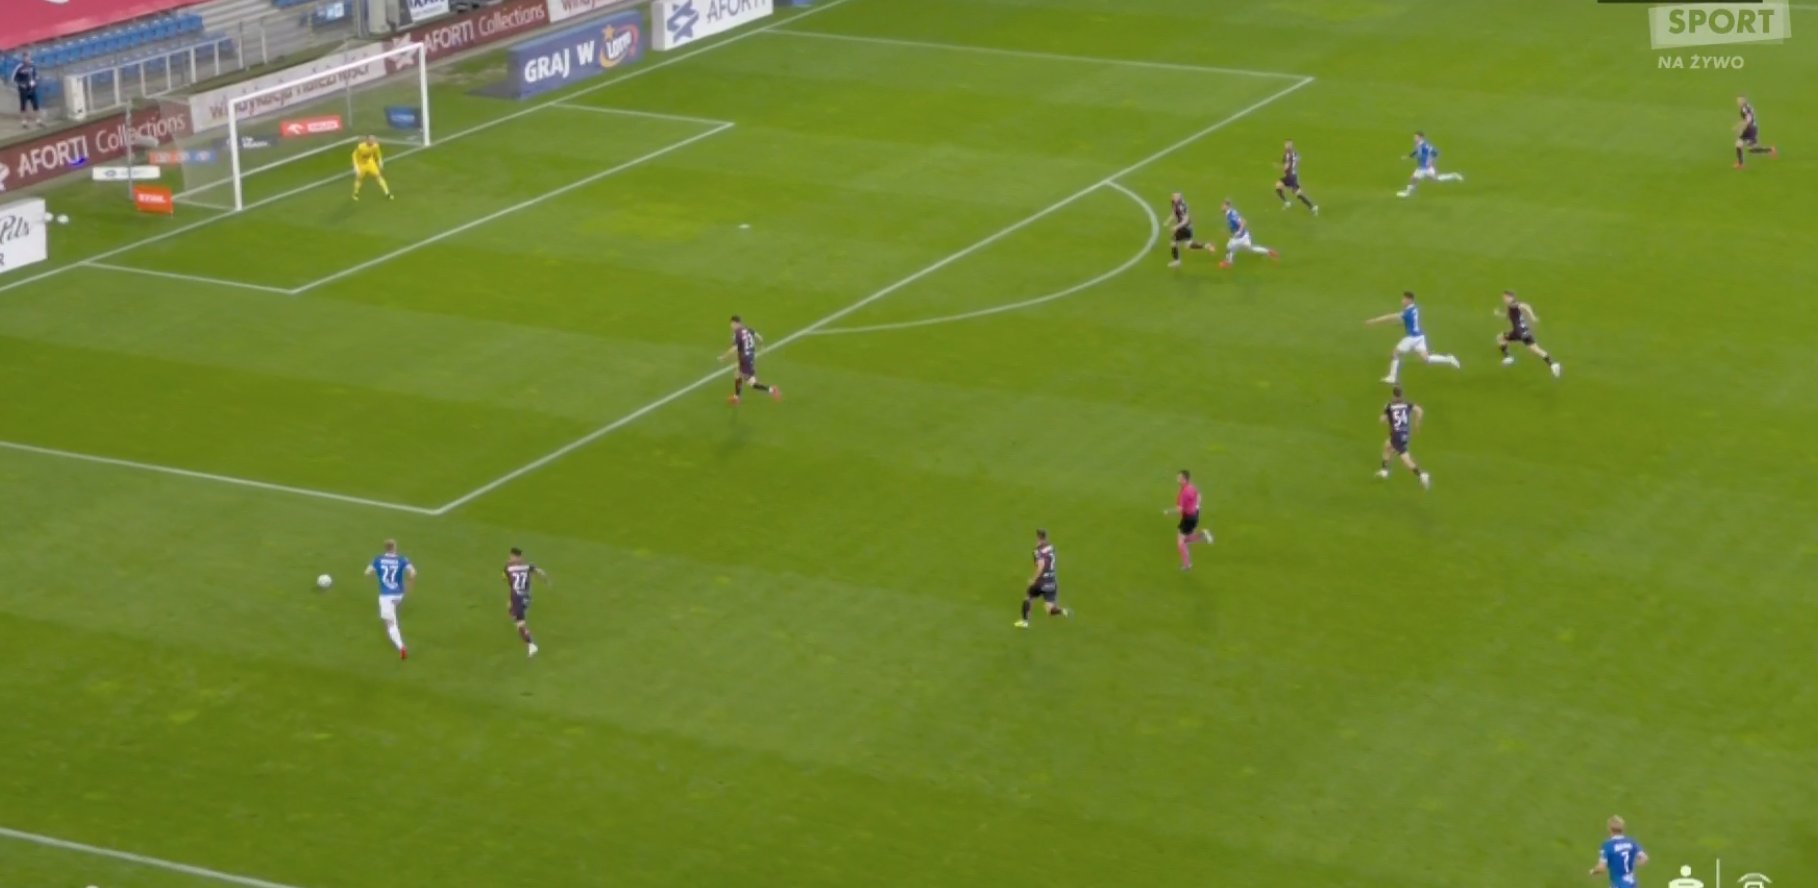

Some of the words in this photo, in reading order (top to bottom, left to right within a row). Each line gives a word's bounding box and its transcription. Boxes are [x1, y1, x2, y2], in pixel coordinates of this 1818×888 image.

[423, 19, 475, 52] AFORTI
[478, 4, 545, 36] Collections
[524, 47, 570, 83] GRAJ
[576, 40, 595, 66] W
[17, 135, 88, 178] AFORTI
[96, 113, 186, 154] Collections
[1392, 408, 1408, 428] 54
[380, 565, 399, 583] 27
[512, 572, 528, 590] 27
[1621, 851, 1630, 873] 7
